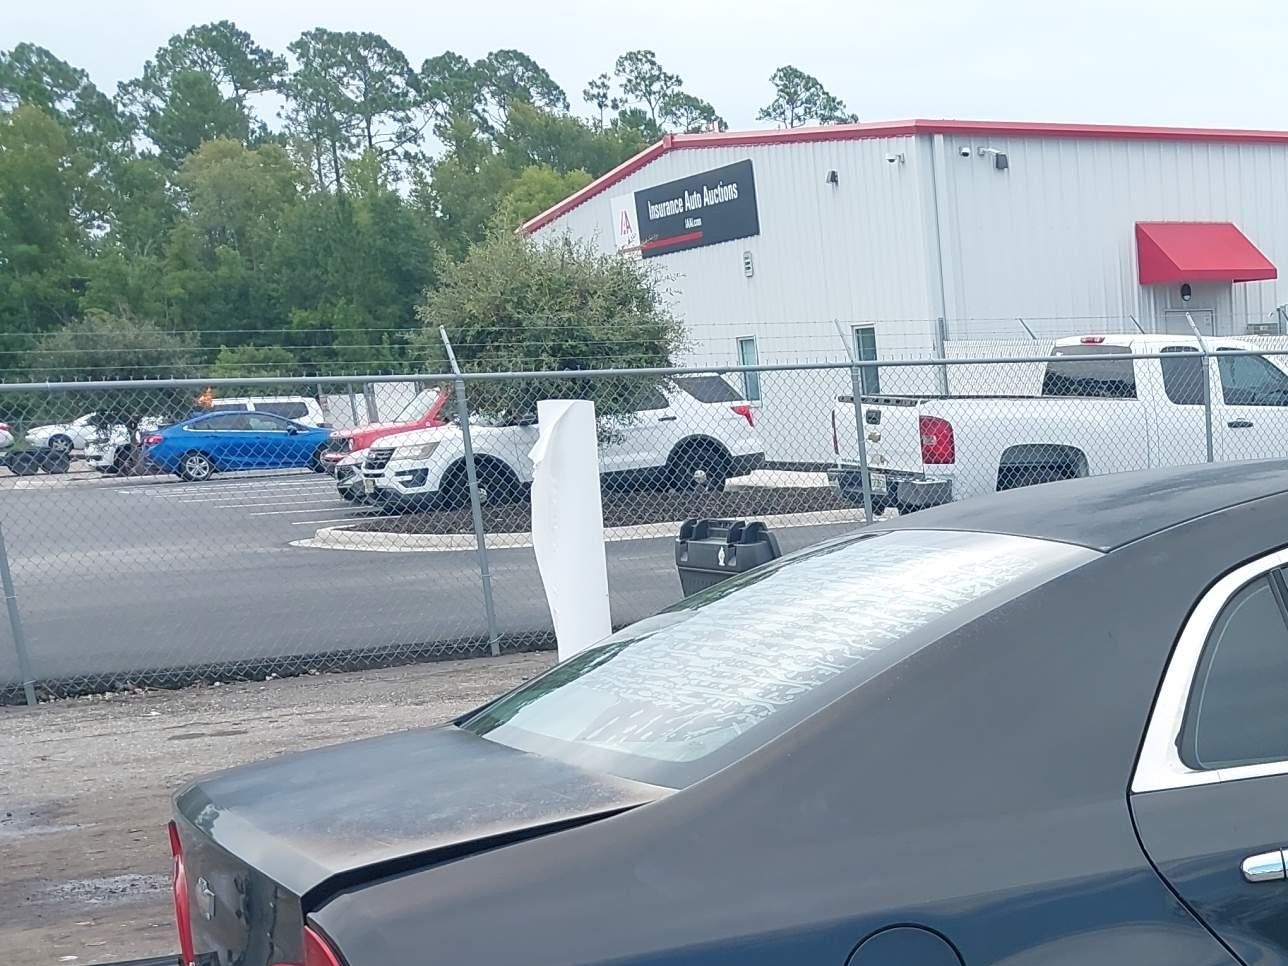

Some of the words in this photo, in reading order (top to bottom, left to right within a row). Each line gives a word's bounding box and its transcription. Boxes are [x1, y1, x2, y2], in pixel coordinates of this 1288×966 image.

[648, 198, 684, 220] Insurance
[684, 190, 702, 212] Auto
[703, 181, 738, 206] Auctions
